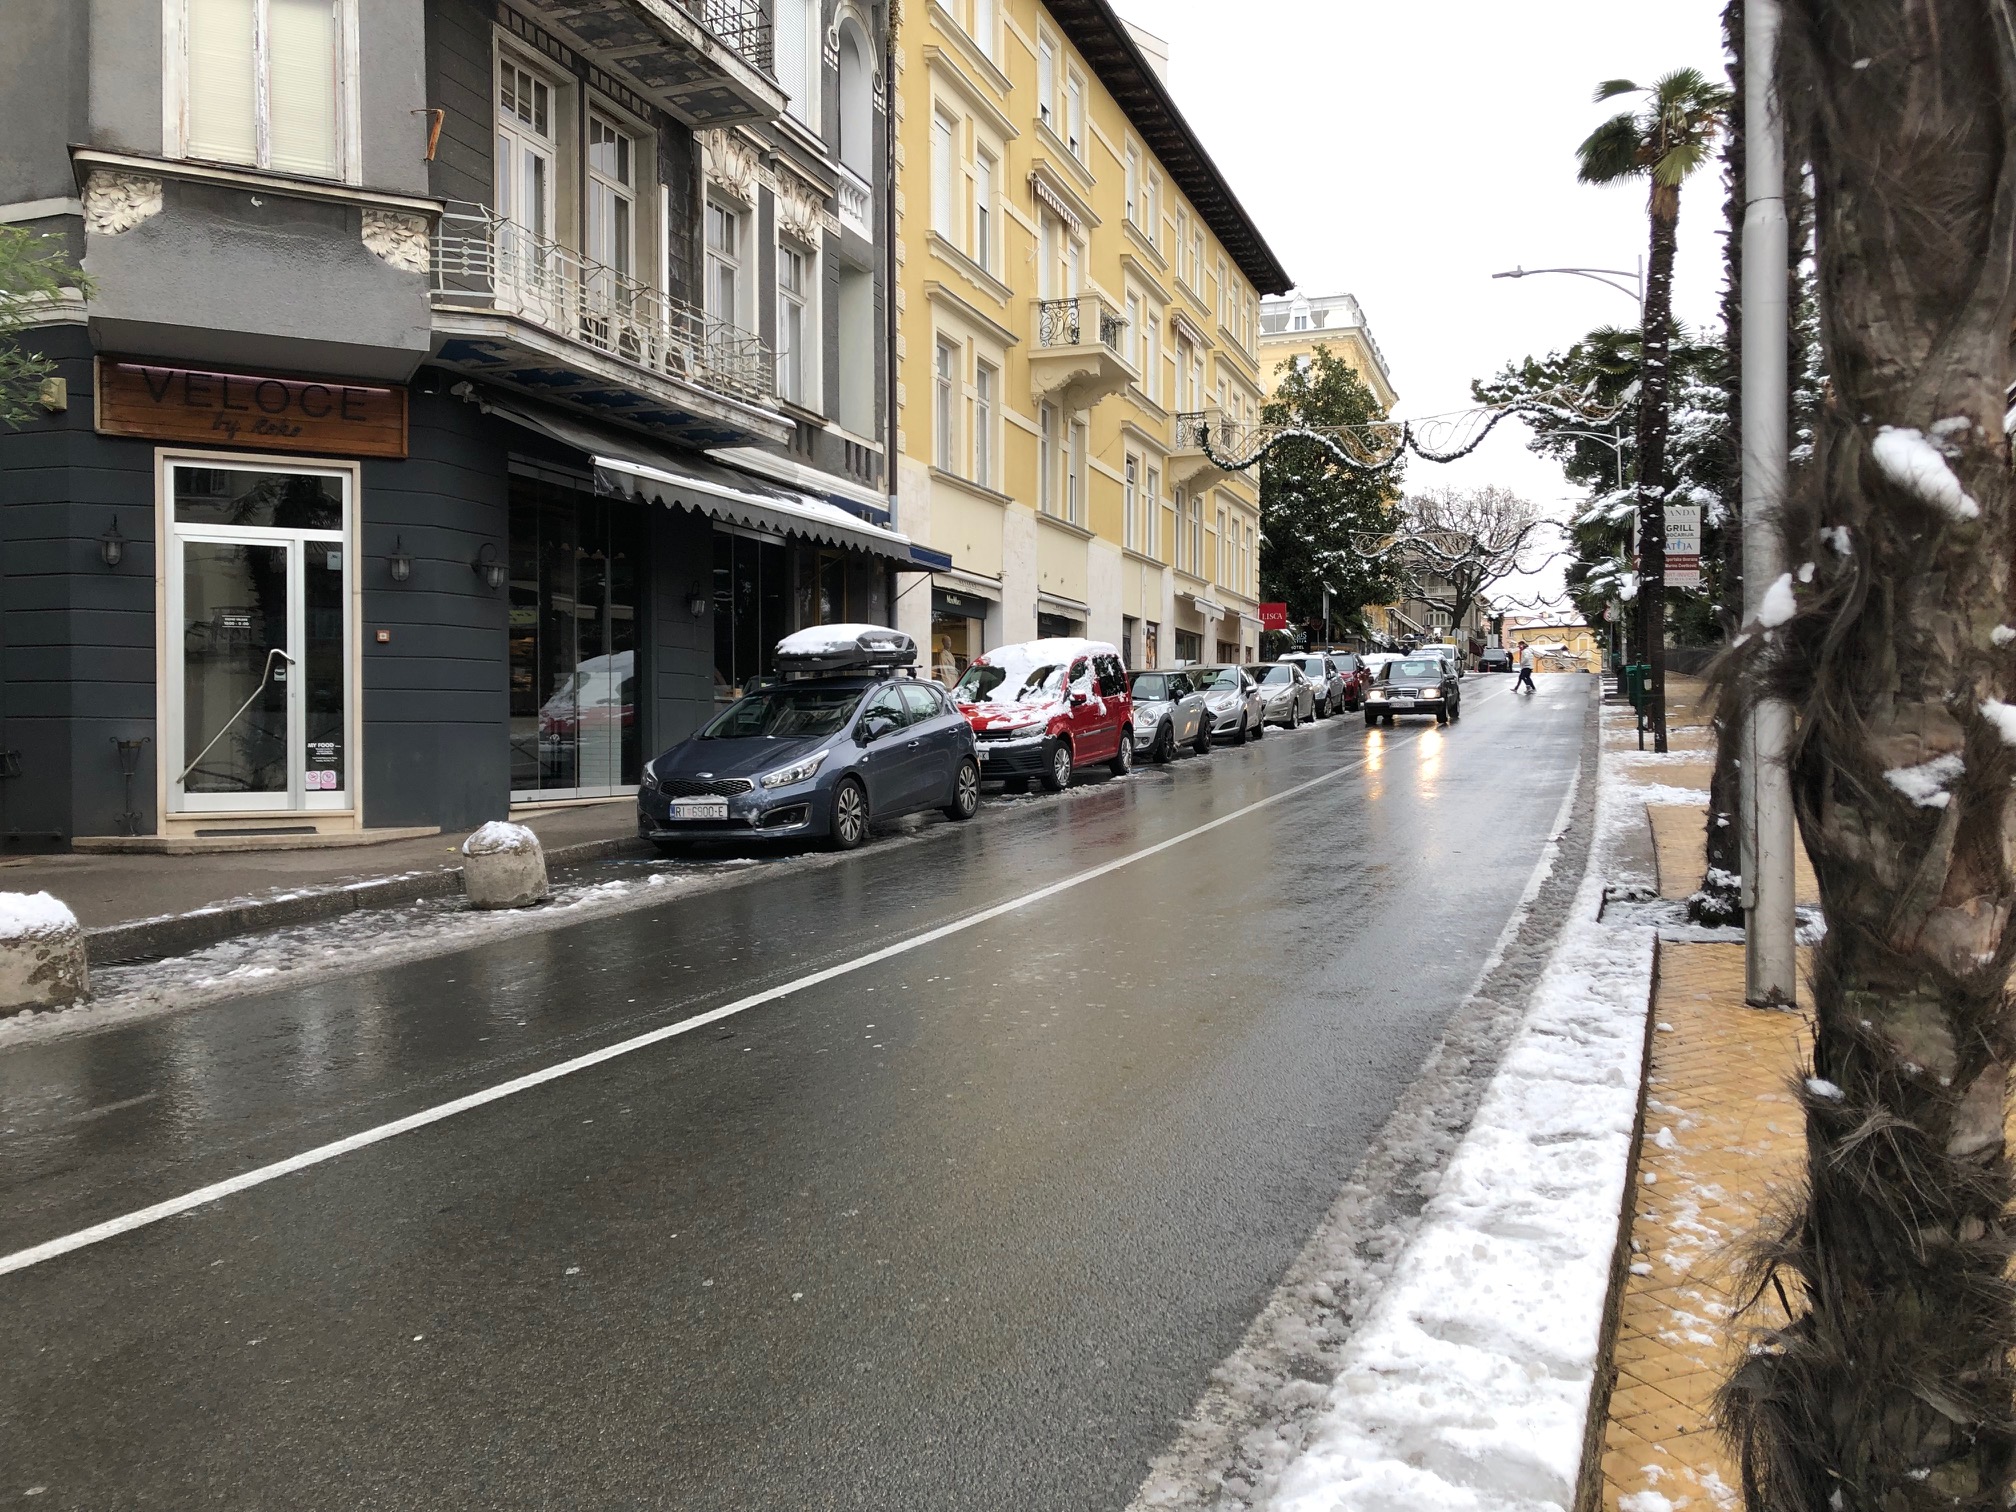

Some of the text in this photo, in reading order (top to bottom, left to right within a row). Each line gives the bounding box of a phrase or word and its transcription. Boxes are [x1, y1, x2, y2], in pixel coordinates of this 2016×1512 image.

[141, 367, 369, 422] VELOCE
[210, 411, 241, 440] by
[1666, 524, 1695, 532] GRILL
[1262, 612, 1283, 620] LISCA
[675, 806, 724, 818] RI 6900-E
